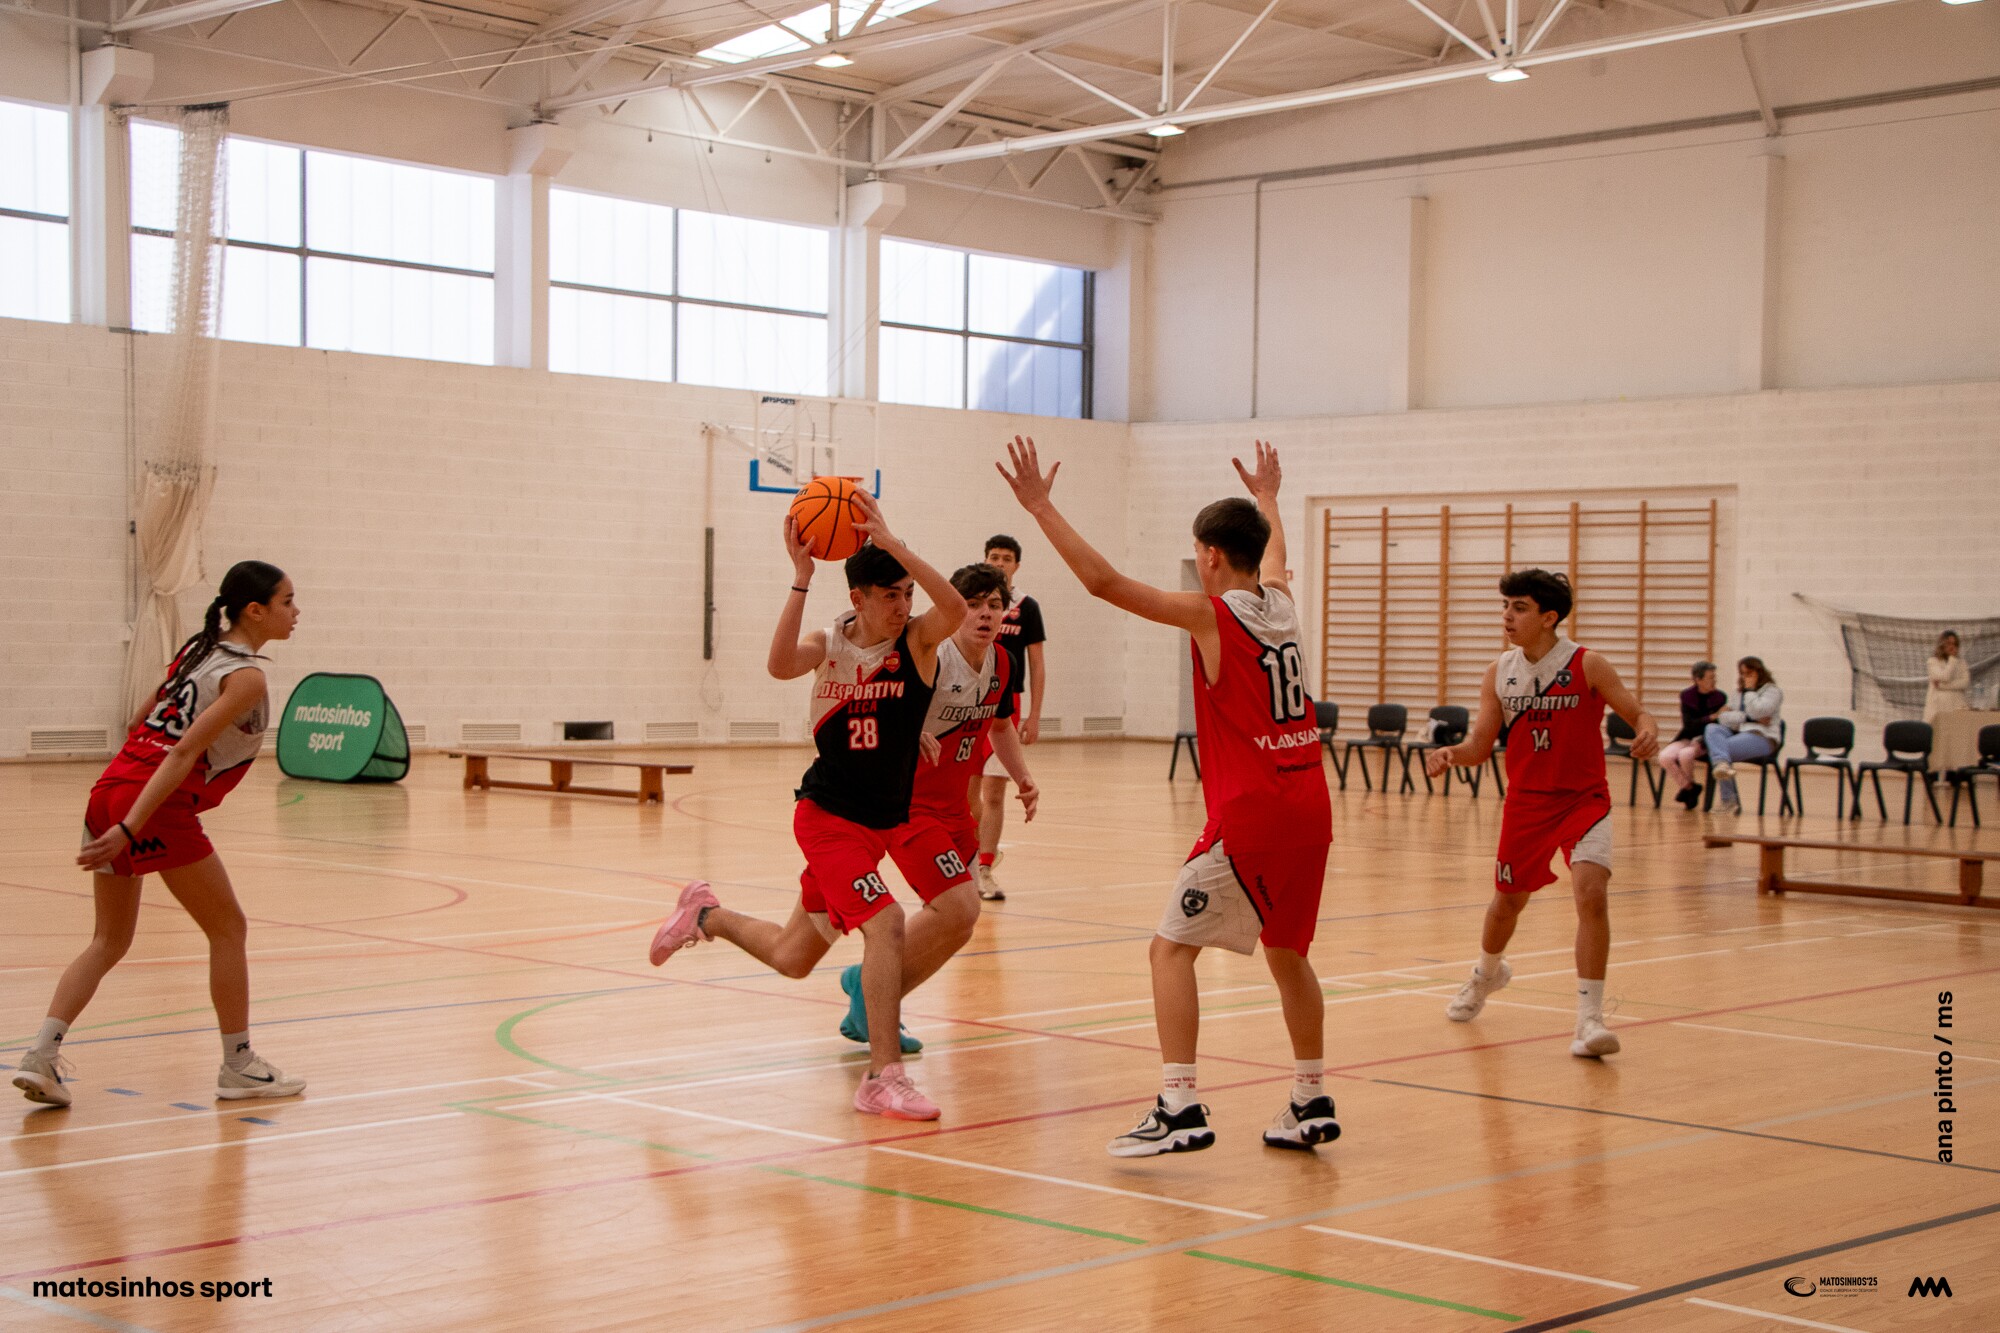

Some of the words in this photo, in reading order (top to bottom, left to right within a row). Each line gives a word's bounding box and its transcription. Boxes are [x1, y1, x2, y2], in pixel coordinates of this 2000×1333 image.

[817, 681, 905, 700] DESPORTIVO
[1257, 641, 1307, 724] 18
[145, 679, 198, 739] 23
[294, 703, 372, 728] matosinhos
[848, 701, 877, 714] LECA
[938, 704, 998, 721] DESPORTIV
[1502, 694, 1580, 712] DESPORTIVO
[1527, 711, 1552, 721] LECA
[308, 731, 345, 754] sport
[847, 716, 880, 751] 28
[1530, 727, 1551, 753] 14
[934, 849, 967, 879] 68
[1497, 859, 1514, 885] 14
[852, 871, 889, 904] 28
